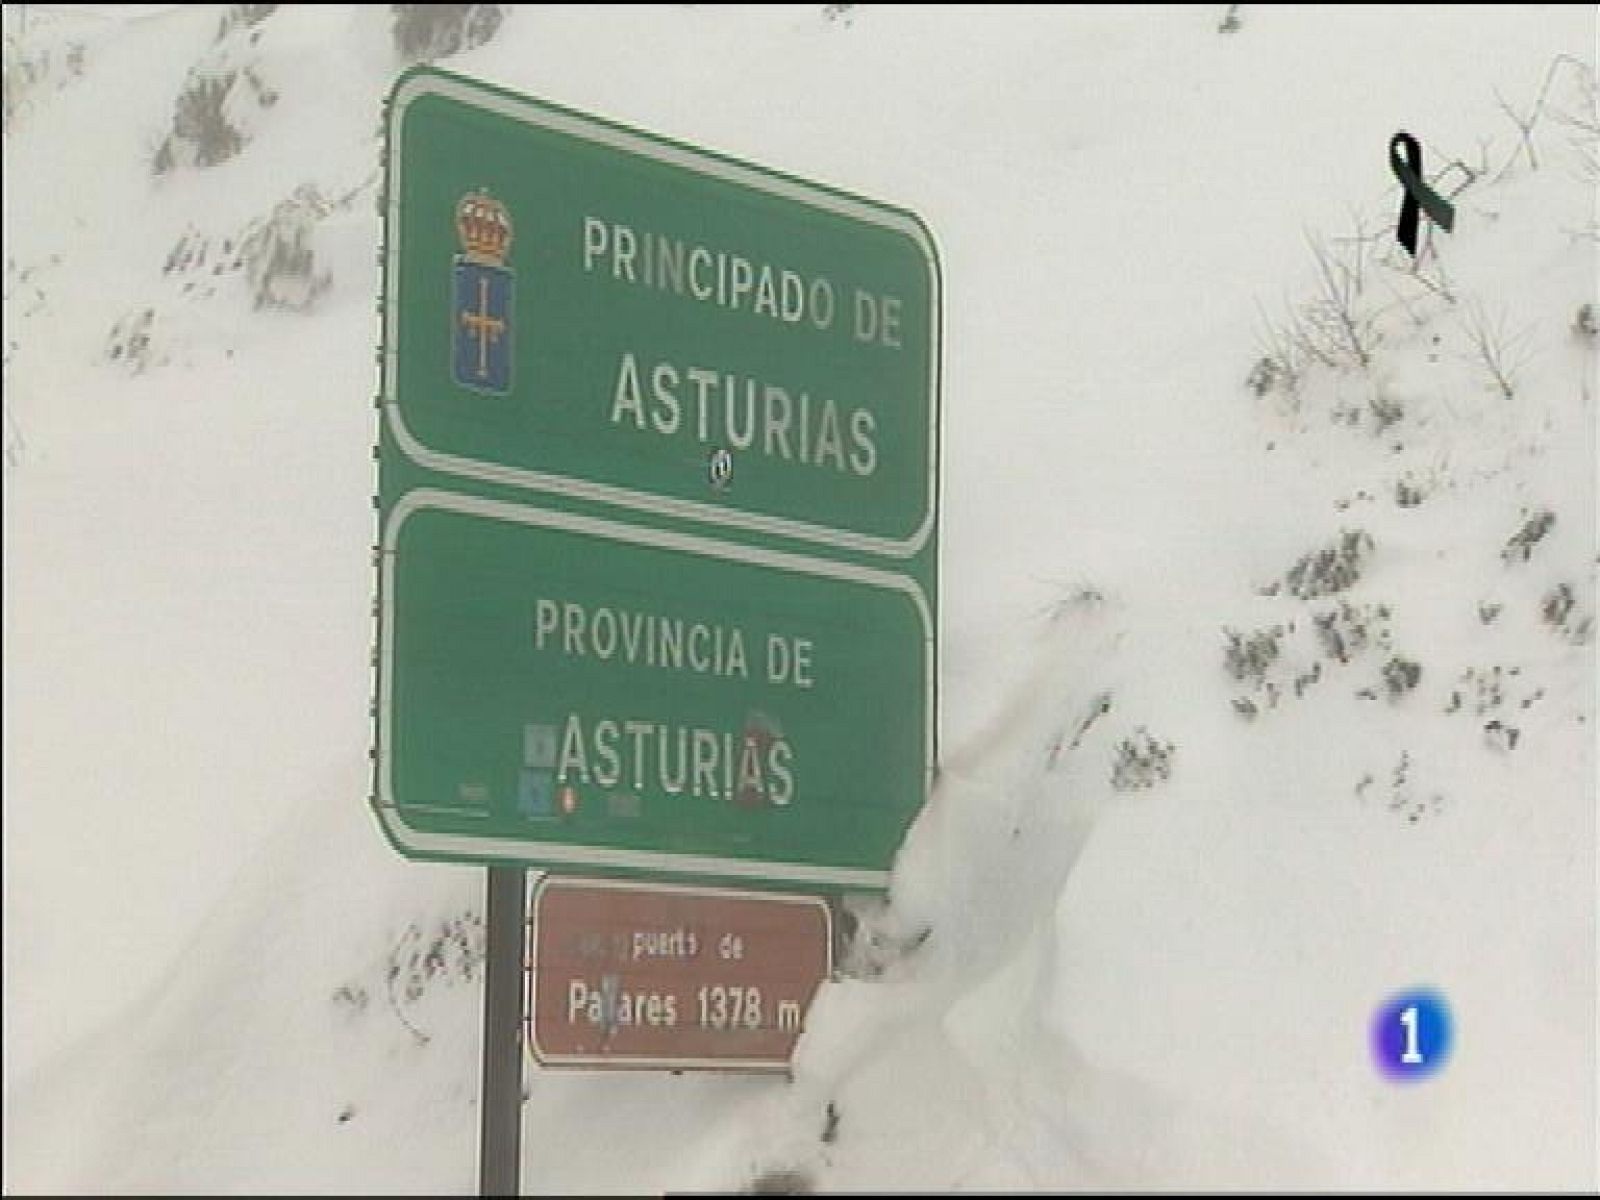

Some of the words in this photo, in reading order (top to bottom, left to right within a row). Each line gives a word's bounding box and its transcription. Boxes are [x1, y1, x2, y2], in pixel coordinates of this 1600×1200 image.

[583, 216, 834, 330] PRINCIPADO
[854, 289, 902, 349] DE
[610, 353, 877, 475] ASTURIAS
[535, 599, 748, 679] PROVINCIA
[766, 633, 815, 688] DE
[556, 711, 794, 805] ASTURIAS
[718, 932, 744, 960] de
[698, 987, 762, 1028] 1378
